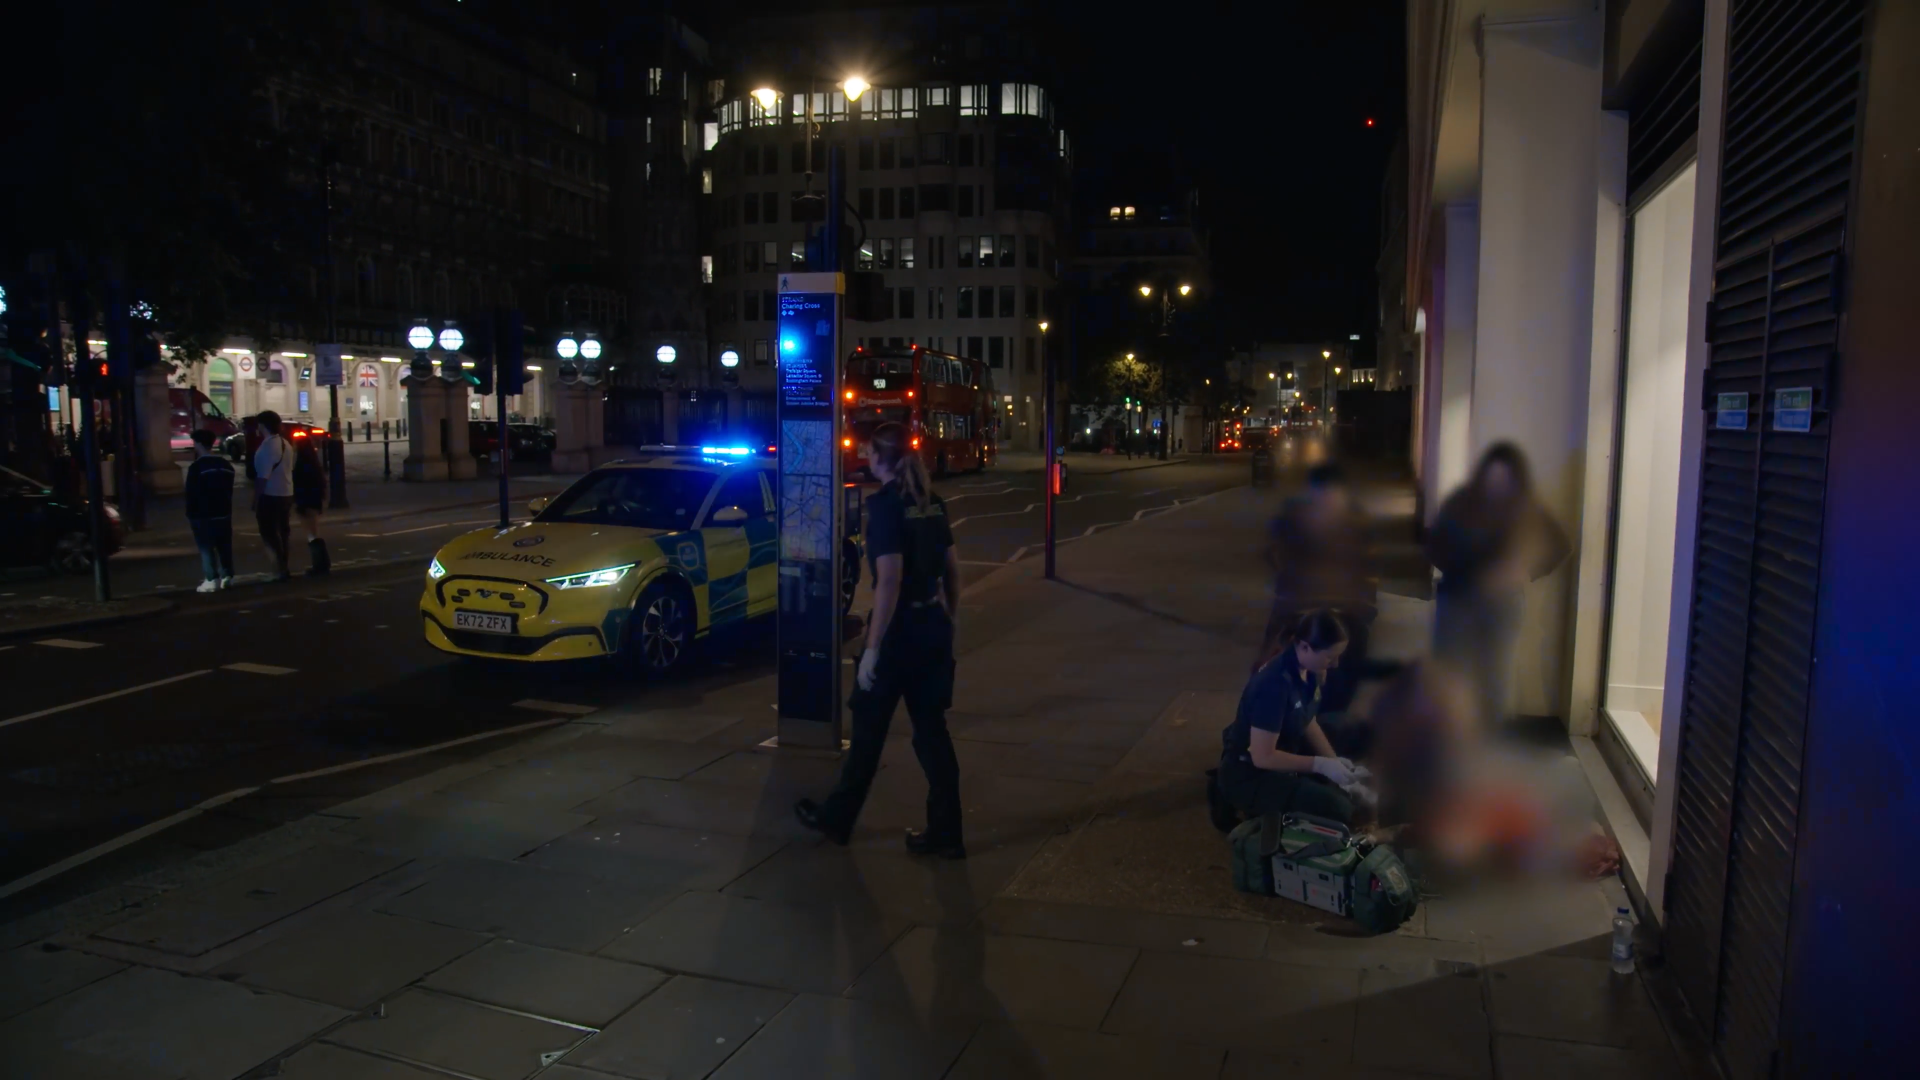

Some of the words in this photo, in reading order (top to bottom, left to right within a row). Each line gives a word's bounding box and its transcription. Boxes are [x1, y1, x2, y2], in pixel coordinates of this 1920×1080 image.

[460, 551, 556, 568] AMBULANCE
[456, 613, 484, 628] EK72
[486, 616, 507, 630] ZFX
